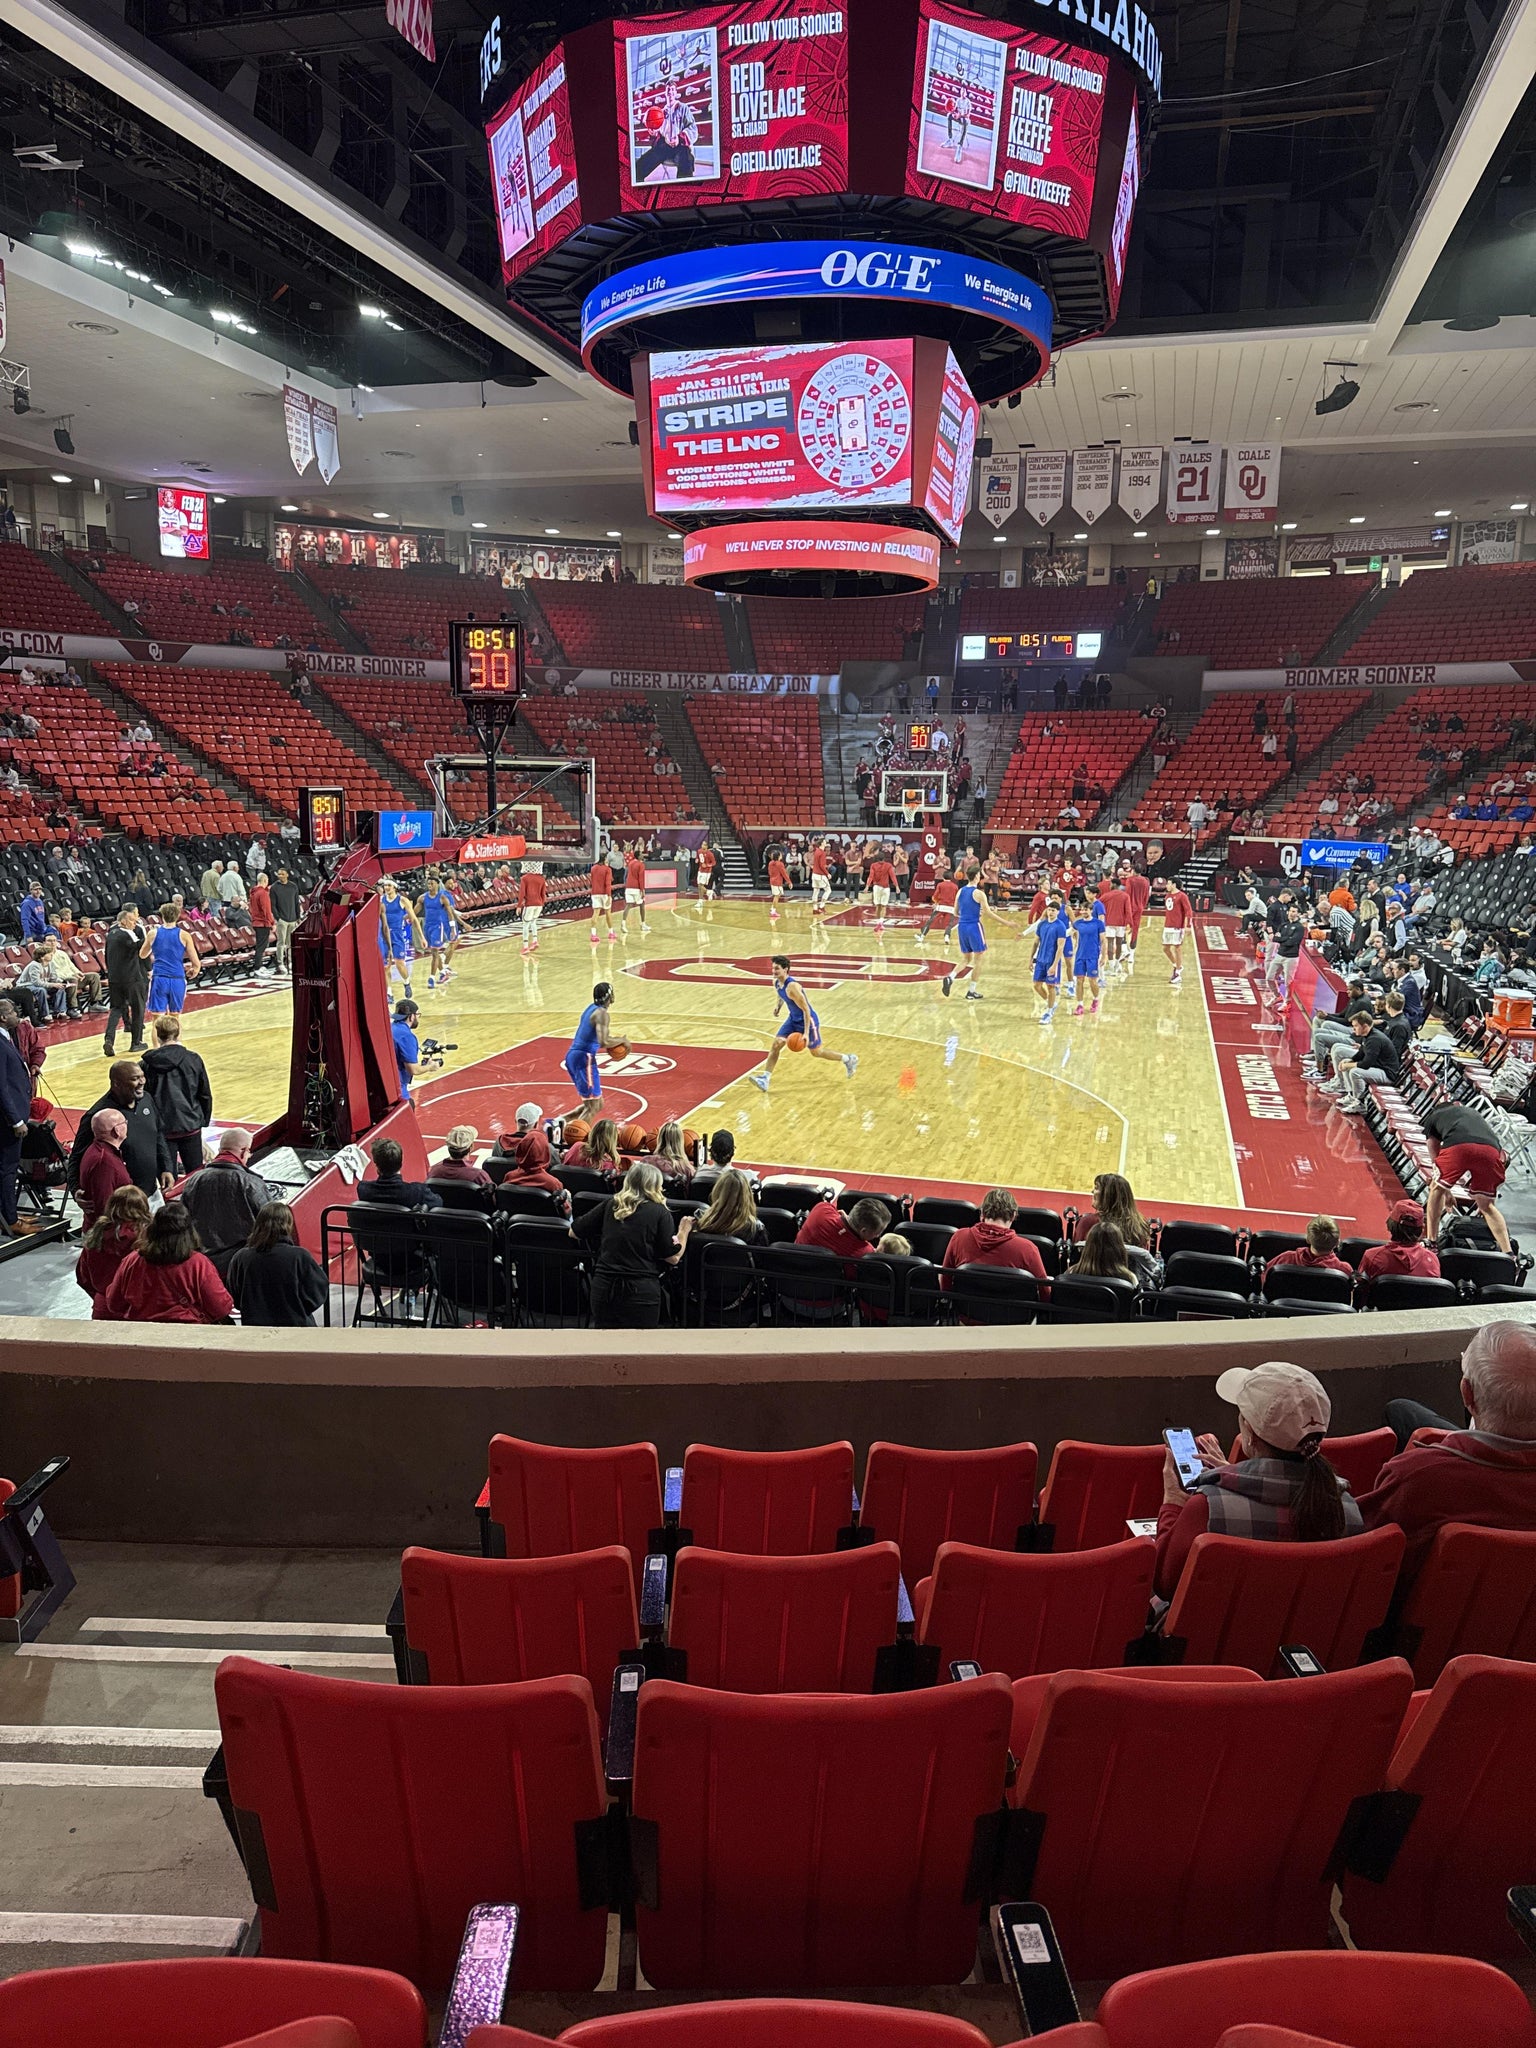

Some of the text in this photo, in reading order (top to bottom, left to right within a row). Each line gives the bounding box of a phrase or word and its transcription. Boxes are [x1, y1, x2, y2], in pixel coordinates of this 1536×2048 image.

[728, 11, 843, 46] FOLLOW YOUR SOONER
[730, 62, 765, 95] REID
[1014, 47, 1103, 94] FOLLOW YOUR SOONER
[730, 86, 806, 124] LOVELACE
[1011, 86, 1054, 125] FINLEY
[744, 120, 768, 137] GUARD
[1008, 116, 1053, 154] KEEFFE
[731, 144, 822, 177] @REID.LOVELACE
[1016, 148, 1044, 166] FORWARD
[1003, 169, 1072, 207] @FINLEYKEEFFE
[600, 275, 666, 310] We Energize Life
[964, 273, 1033, 311] We Energize Life
[659, 378, 790, 408] MEN'S BASKETBALL VS. TEXAS
[676, 379, 709, 392] JAN.
[664, 396, 788, 433] STRIPE
[672, 434, 780, 456] THE LNC
[991, 457, 1009, 465] NCAA
[1028, 455, 1065, 464] CONFERENCE
[1122, 459, 1159, 467] CHAMPIONS
[1131, 452, 1152, 460] WNIT
[1179, 453, 1213, 464] DALES
[1238, 450, 1271, 461] COALE
[667, 465, 714, 476] STUDENT
[760, 459, 794, 469] WHITE
[676, 474, 698, 483] ODD
[752, 467, 786, 477] WHITE
[983, 464, 1018, 473] FINAL FOUR
[1028, 463, 1063, 471] CHAMPIONS
[668, 482, 694, 491] EVEN
[748, 474, 795, 485] CRIMSON
[1094, 482, 1108, 490] 2007
[1128, 475, 1151, 487] 1994
[1176, 466, 1210, 502] 21
[1238, 465, 1266, 500] OU
[181, 495, 204, 512] FEB 24
[986, 496, 1011, 510] 2010
[350, 539, 366, 556] 10
[725, 539, 934, 565] WE'LL NEVER STOP INVESTING IN RELIABILITY
[532, 550, 556, 579] OU
[1229, 563, 1275, 574] CHAMPIONS
[467, 629, 515, 650] 18:51
[1020, 634, 1047, 646] 18:51
[148, 643, 163, 662] OU
[998, 642, 1073, 656] 0 0
[361, 657, 427, 677] SOONER
[469, 652, 510, 688] 30
[1285, 665, 1436, 687] BOOMER SOONER
[610, 671, 812, 692] CHEER LIKE A CHAMPION
[911, 725, 930, 734] 18:51
[911, 734, 927, 748] 30
[315, 817, 334, 843] 30
[298, 977, 331, 989] SPALDING
[1245, 1093, 1291, 1121] CLUB
[31, 1513, 40, 1526] 4
